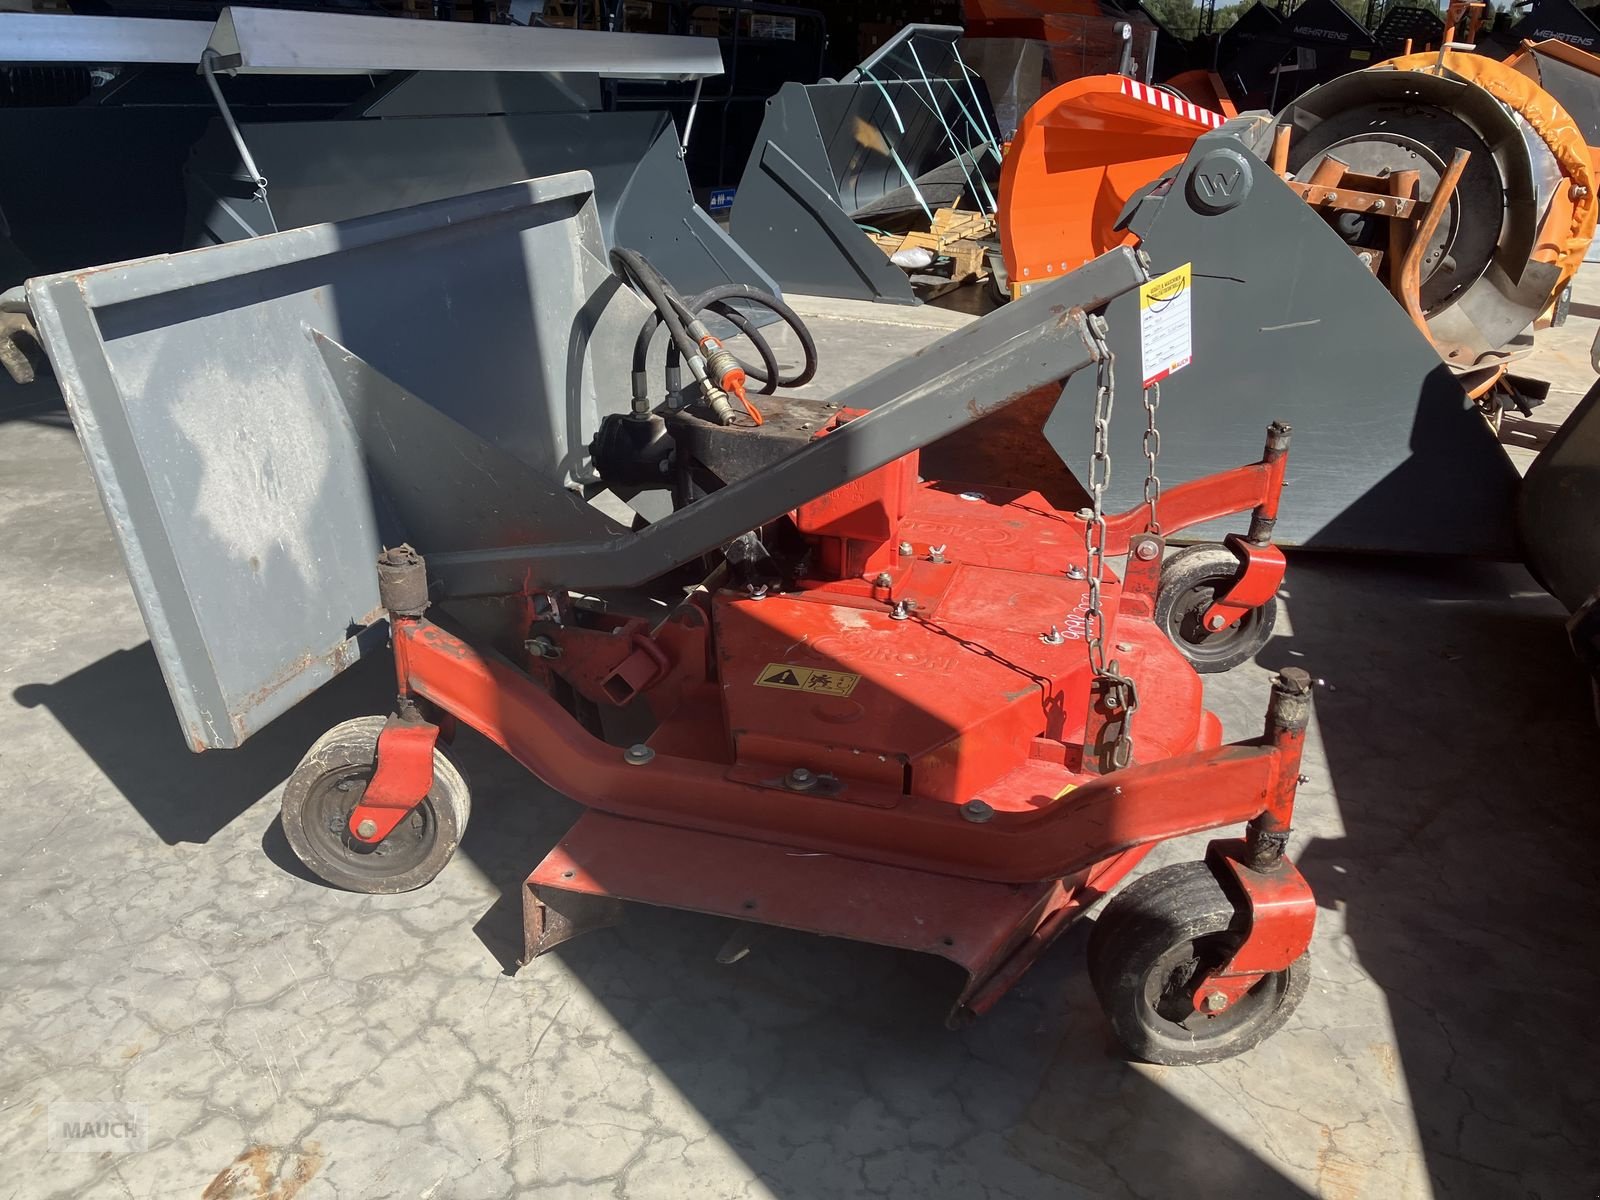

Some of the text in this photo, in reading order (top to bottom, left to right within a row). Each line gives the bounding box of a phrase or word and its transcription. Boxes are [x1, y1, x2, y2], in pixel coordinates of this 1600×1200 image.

[1293, 25, 1350, 41] MEHRTENS
[1533, 28, 1595, 46] MEHRTENS
[1199, 171, 1241, 197] W
